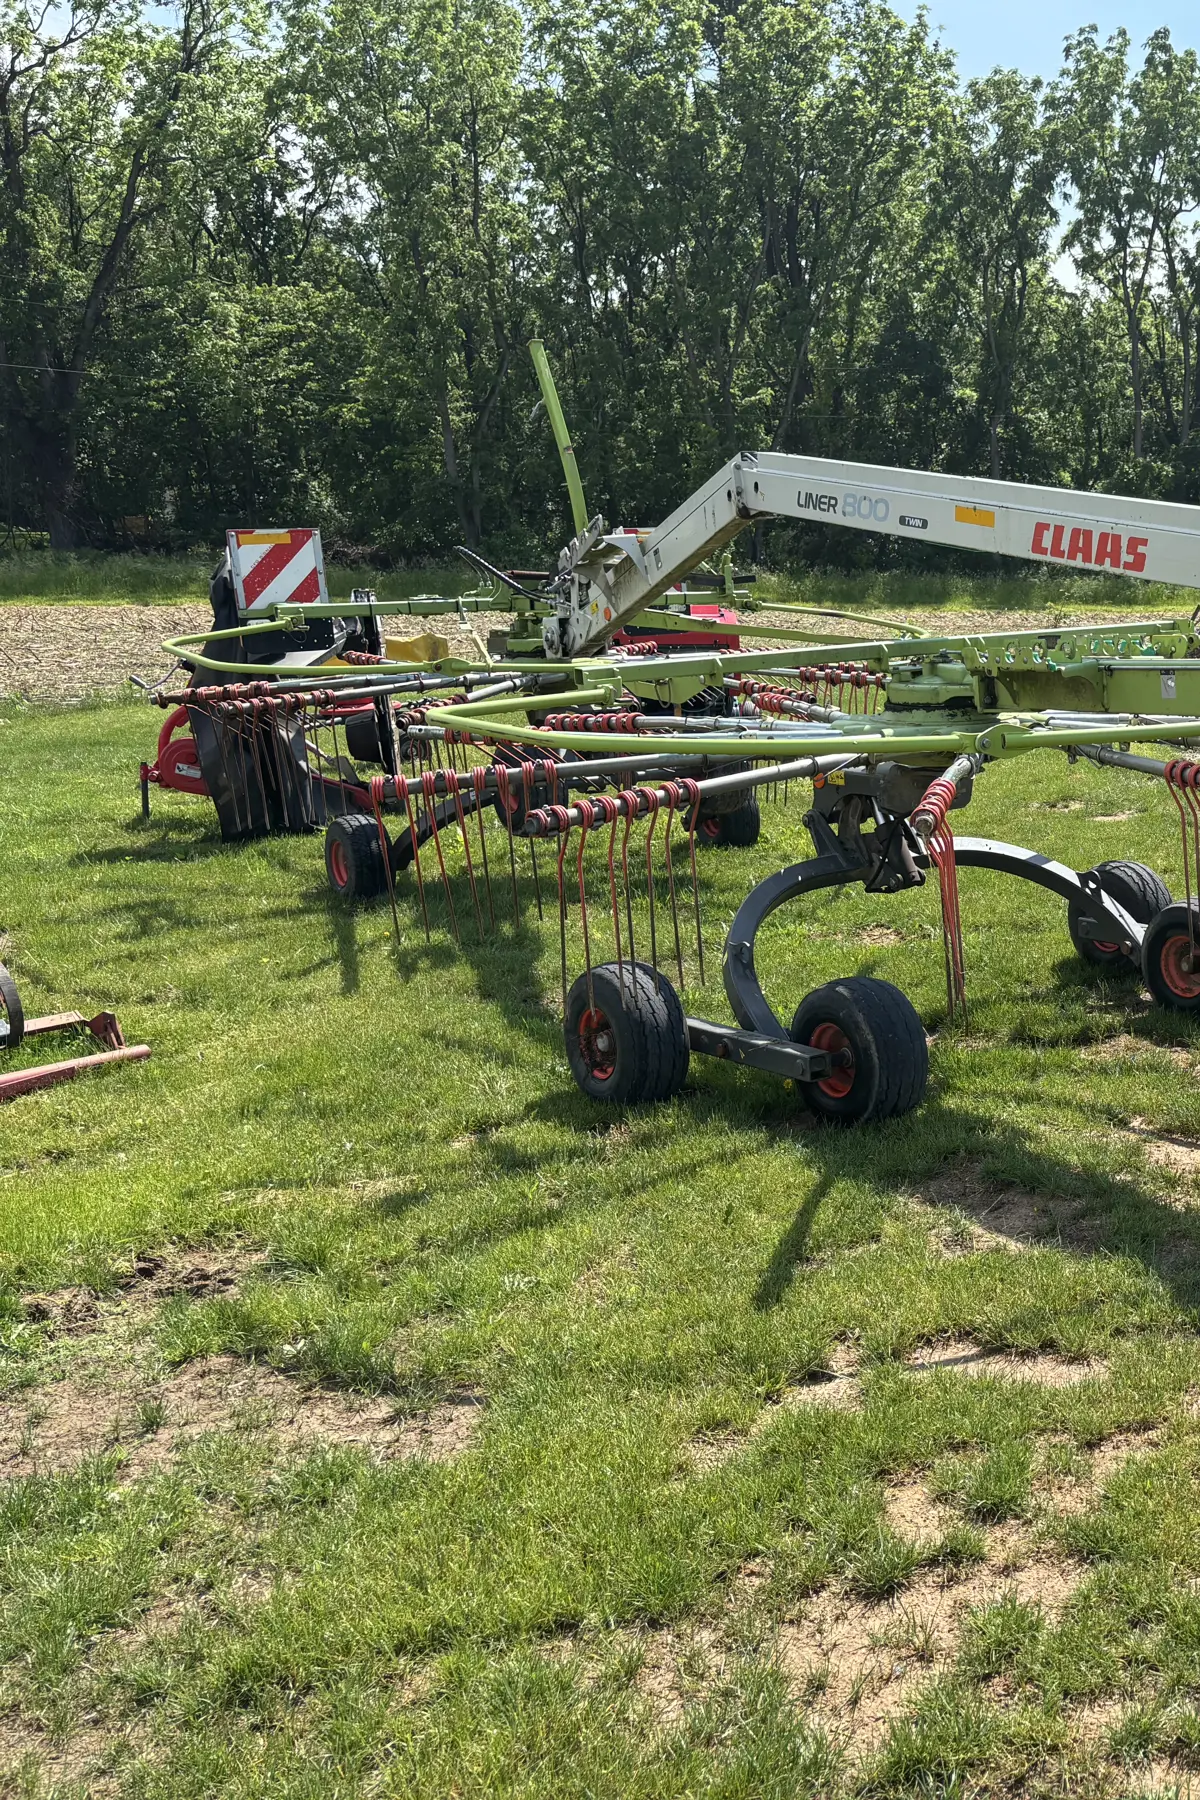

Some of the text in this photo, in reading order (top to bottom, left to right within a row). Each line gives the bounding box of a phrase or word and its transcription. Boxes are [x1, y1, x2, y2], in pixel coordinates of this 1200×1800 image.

[797, 490, 923, 528] LINER 800 TWIN
[1031, 521, 1149, 573] CLAAS
